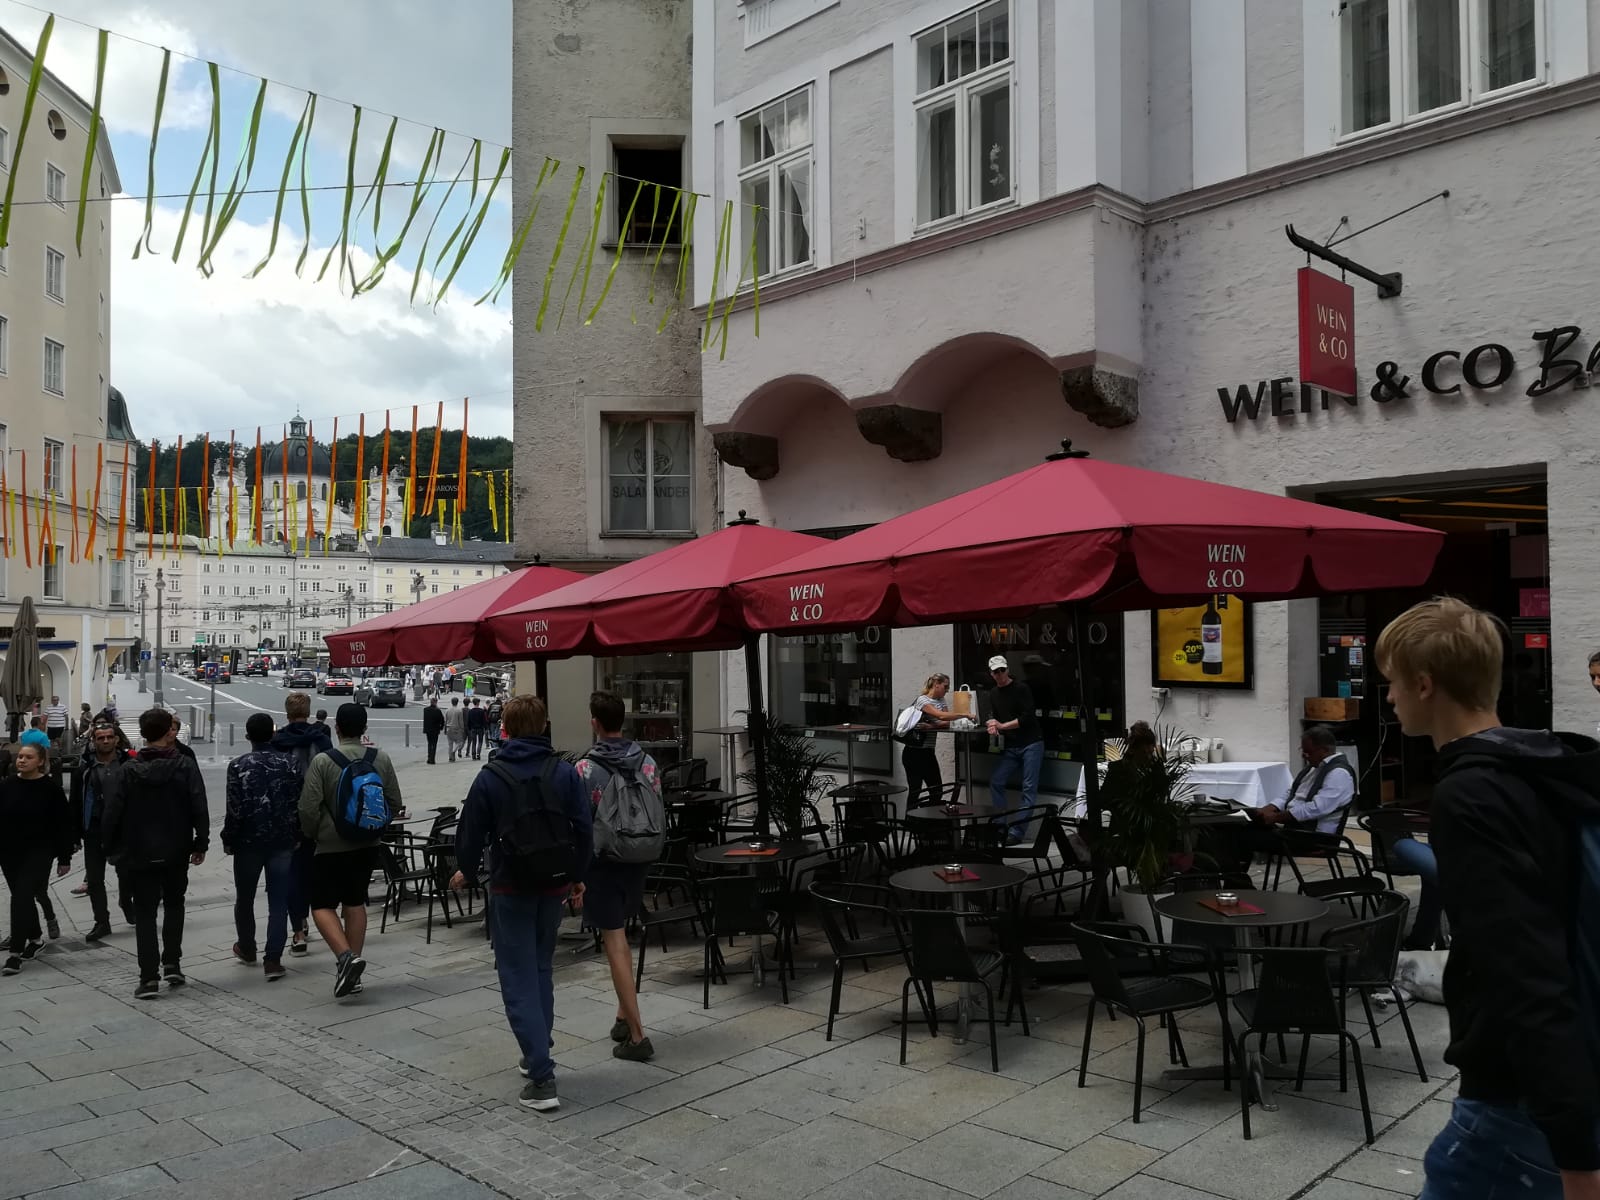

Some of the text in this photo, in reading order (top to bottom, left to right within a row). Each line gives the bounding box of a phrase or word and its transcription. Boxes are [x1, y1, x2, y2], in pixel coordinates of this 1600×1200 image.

[1317, 304, 1347, 333] WEIN
[1320, 333, 1347, 360] & CO
[1370, 361, 1410, 403] &
[1421, 343, 1514, 394] CO
[1207, 544, 1246, 563] WEIN
[1207, 569, 1245, 588] & CO
[790, 583, 824, 601] WEIN
[790, 603, 823, 622] & CO
[525, 619, 549, 633] WEIN
[971, 622, 1030, 645] WEIN
[1039, 622, 1057, 644] &
[526, 634, 548, 649] & CO
[356, 653, 366, 664] CO
